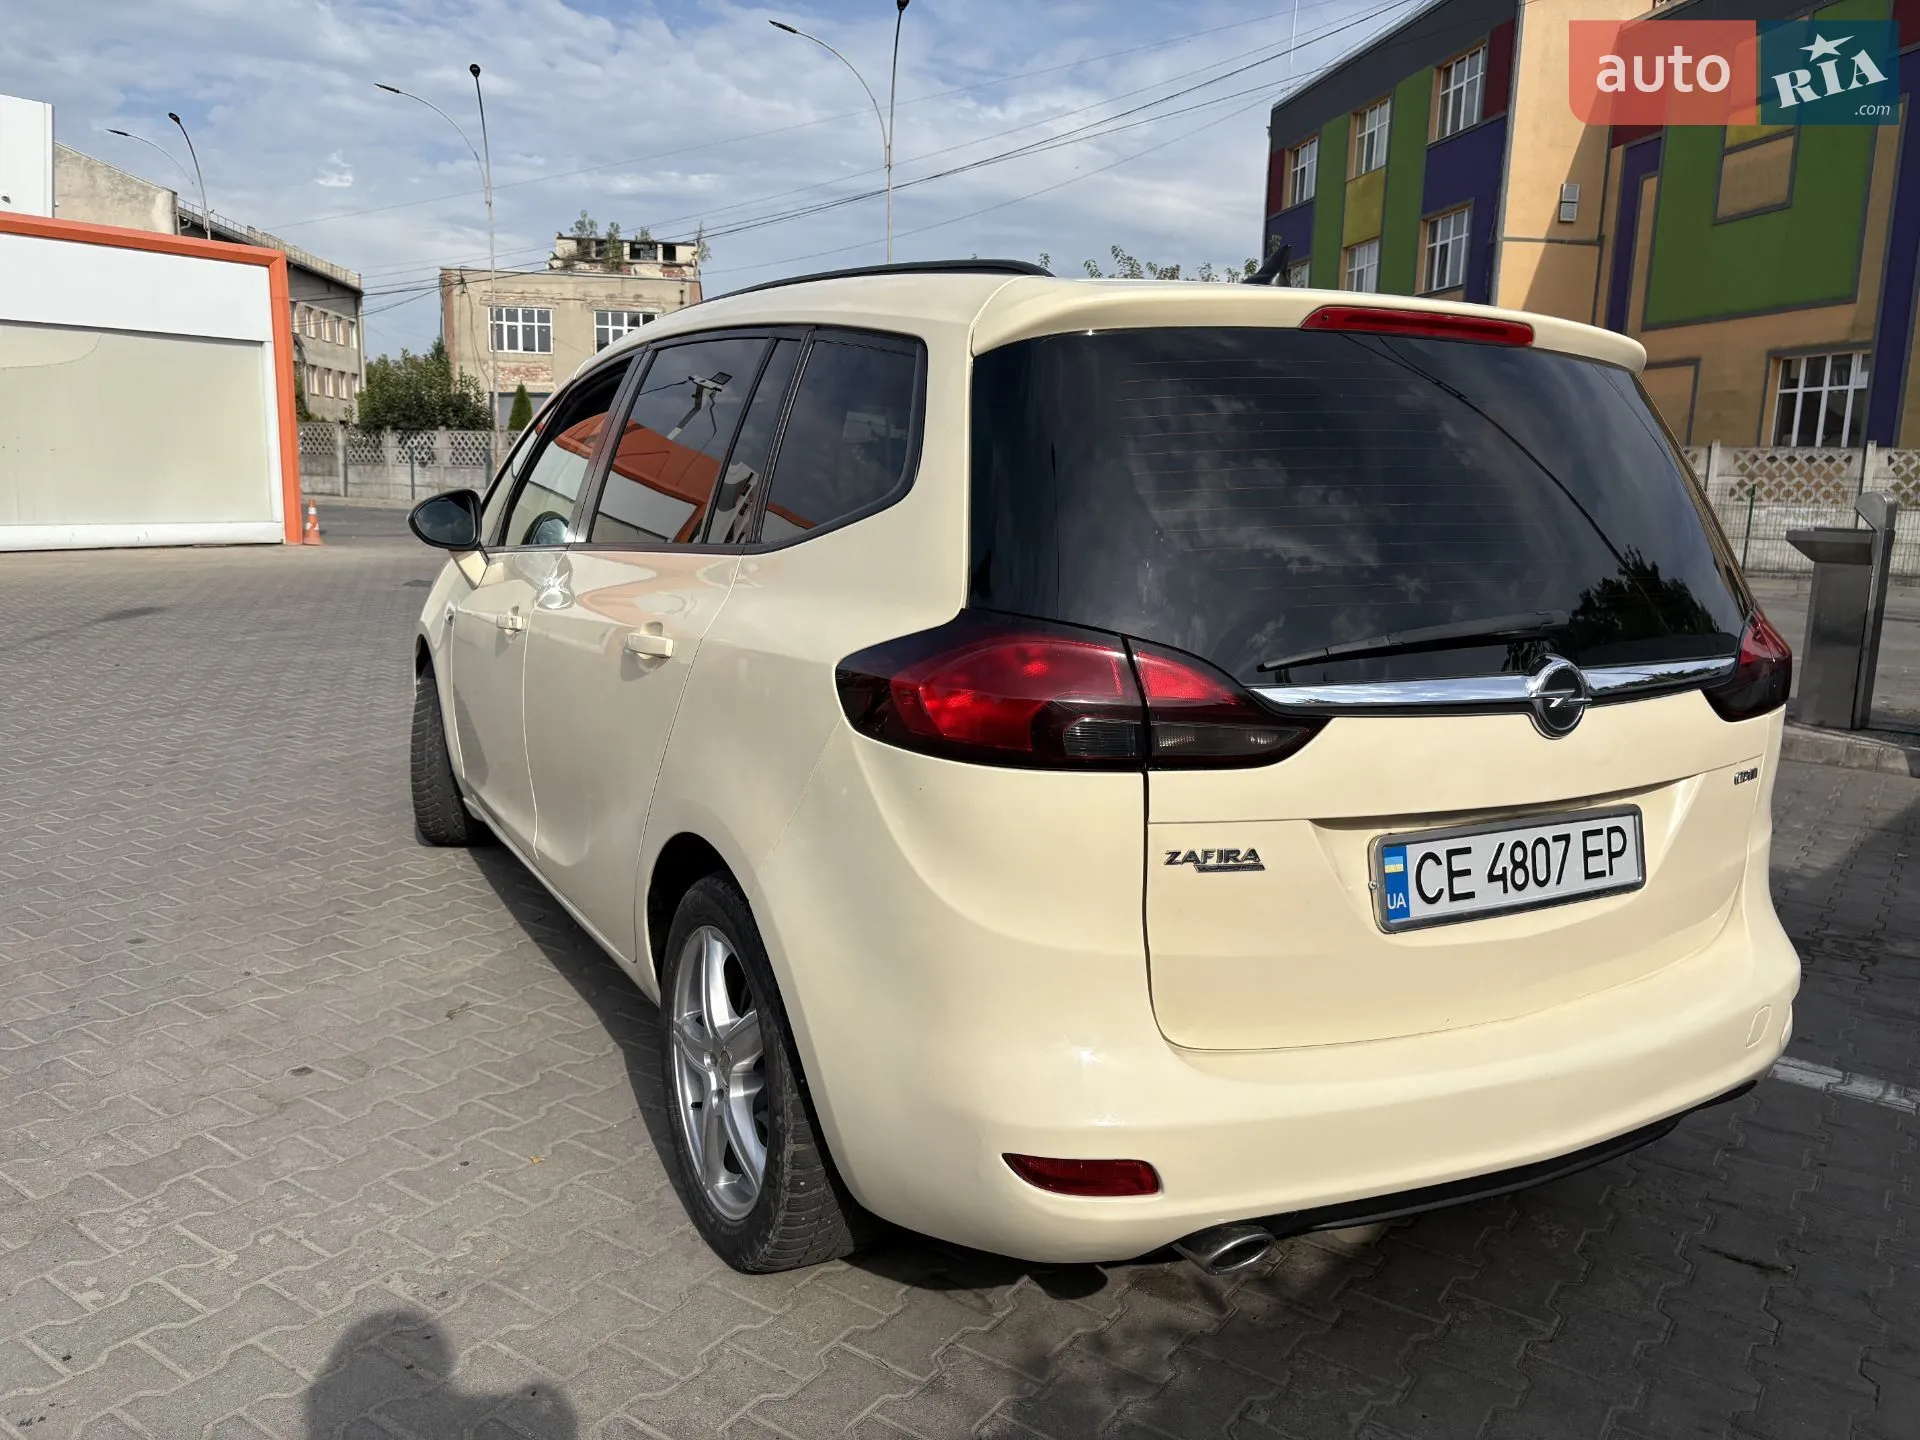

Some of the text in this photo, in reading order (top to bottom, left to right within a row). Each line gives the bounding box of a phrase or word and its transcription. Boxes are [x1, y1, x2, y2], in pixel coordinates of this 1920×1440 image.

[1163, 847, 1261, 866] ZAFIRA
[1415, 825, 1628, 905] CE 4807 EP
[1386, 892, 1408, 910] UA
